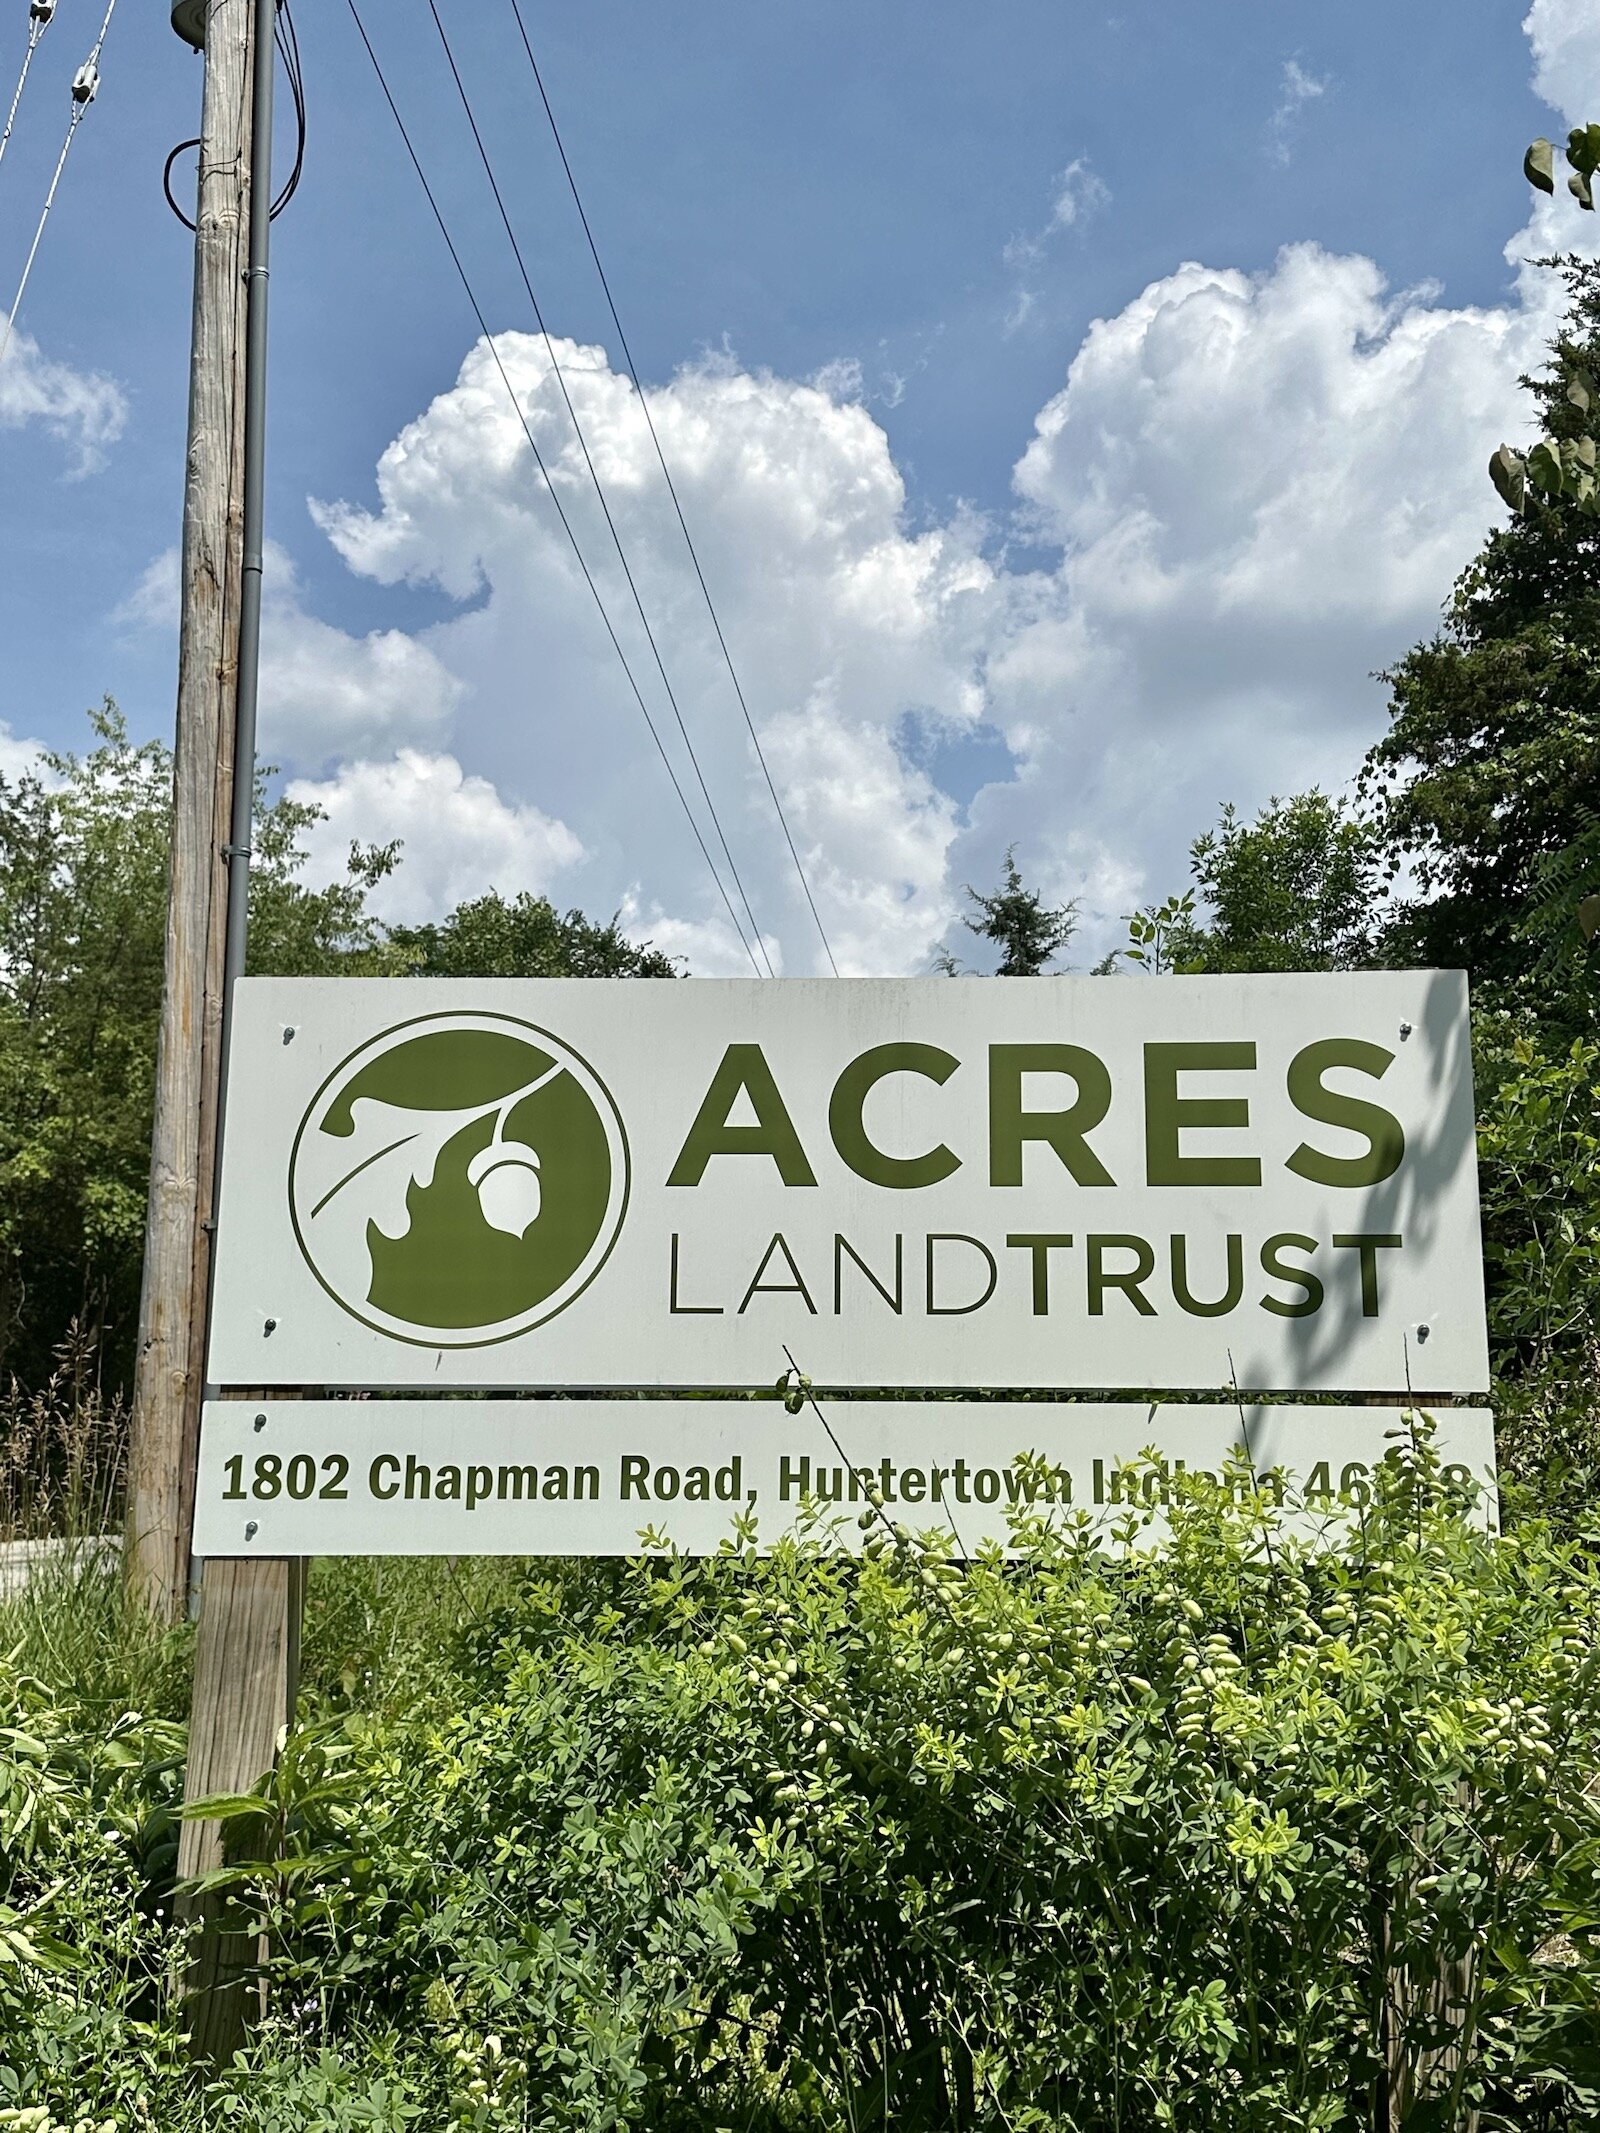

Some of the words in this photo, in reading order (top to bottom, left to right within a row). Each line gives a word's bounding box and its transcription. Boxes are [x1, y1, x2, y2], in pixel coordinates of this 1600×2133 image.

[665, 1038, 1405, 1188] ACRES
[221, 1454, 350, 1500] 1802
[368, 1454, 600, 1510] Chapman
[619, 1455, 757, 1509] Road,
[779, 1456, 1073, 1504] Huntertown
[1093, 1459, 1284, 1507] Indina
[1302, 1461, 1473, 1510] 468
